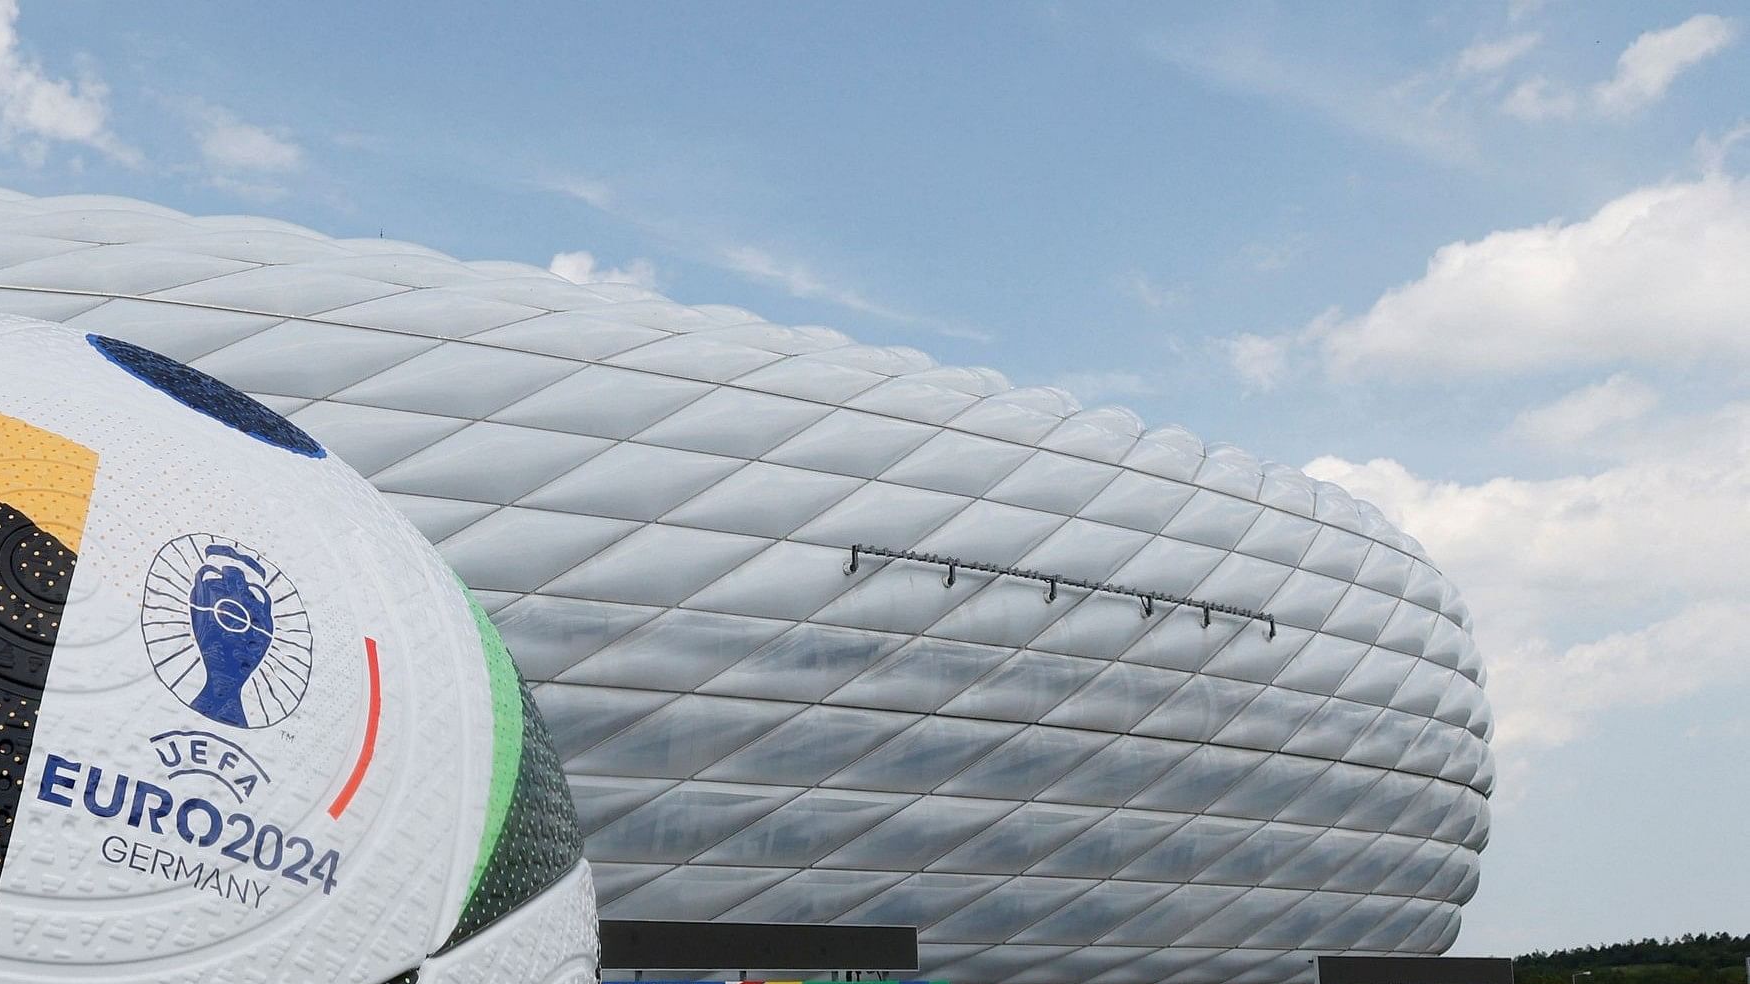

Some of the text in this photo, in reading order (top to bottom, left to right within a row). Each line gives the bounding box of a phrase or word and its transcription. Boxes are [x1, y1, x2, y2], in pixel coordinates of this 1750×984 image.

[155, 740, 259, 798] UEFA
[36, 753, 341, 896] EURO2024
[101, 835, 271, 910] GERMANY
